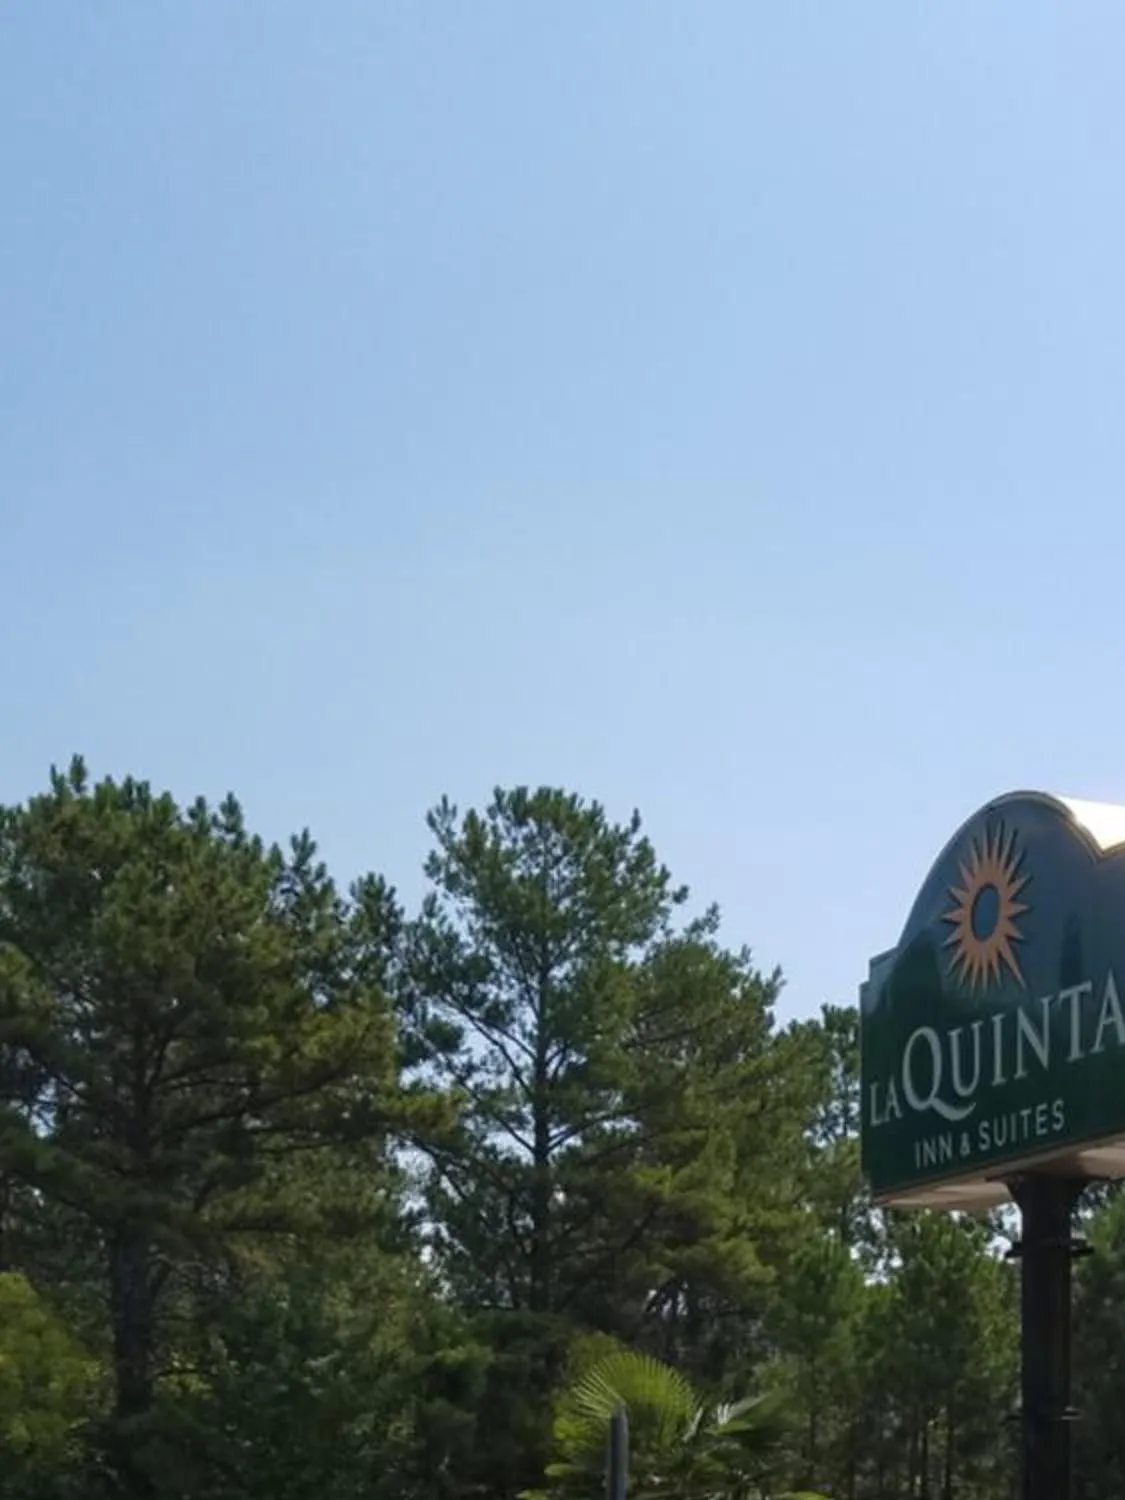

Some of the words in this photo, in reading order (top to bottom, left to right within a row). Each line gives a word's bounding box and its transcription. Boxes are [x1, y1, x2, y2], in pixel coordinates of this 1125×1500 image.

[870, 1076, 902, 1127] LA
[915, 1131, 953, 1168] INN
[959, 1134, 972, 1156] &
[978, 1099, 1065, 1147] SUITES
